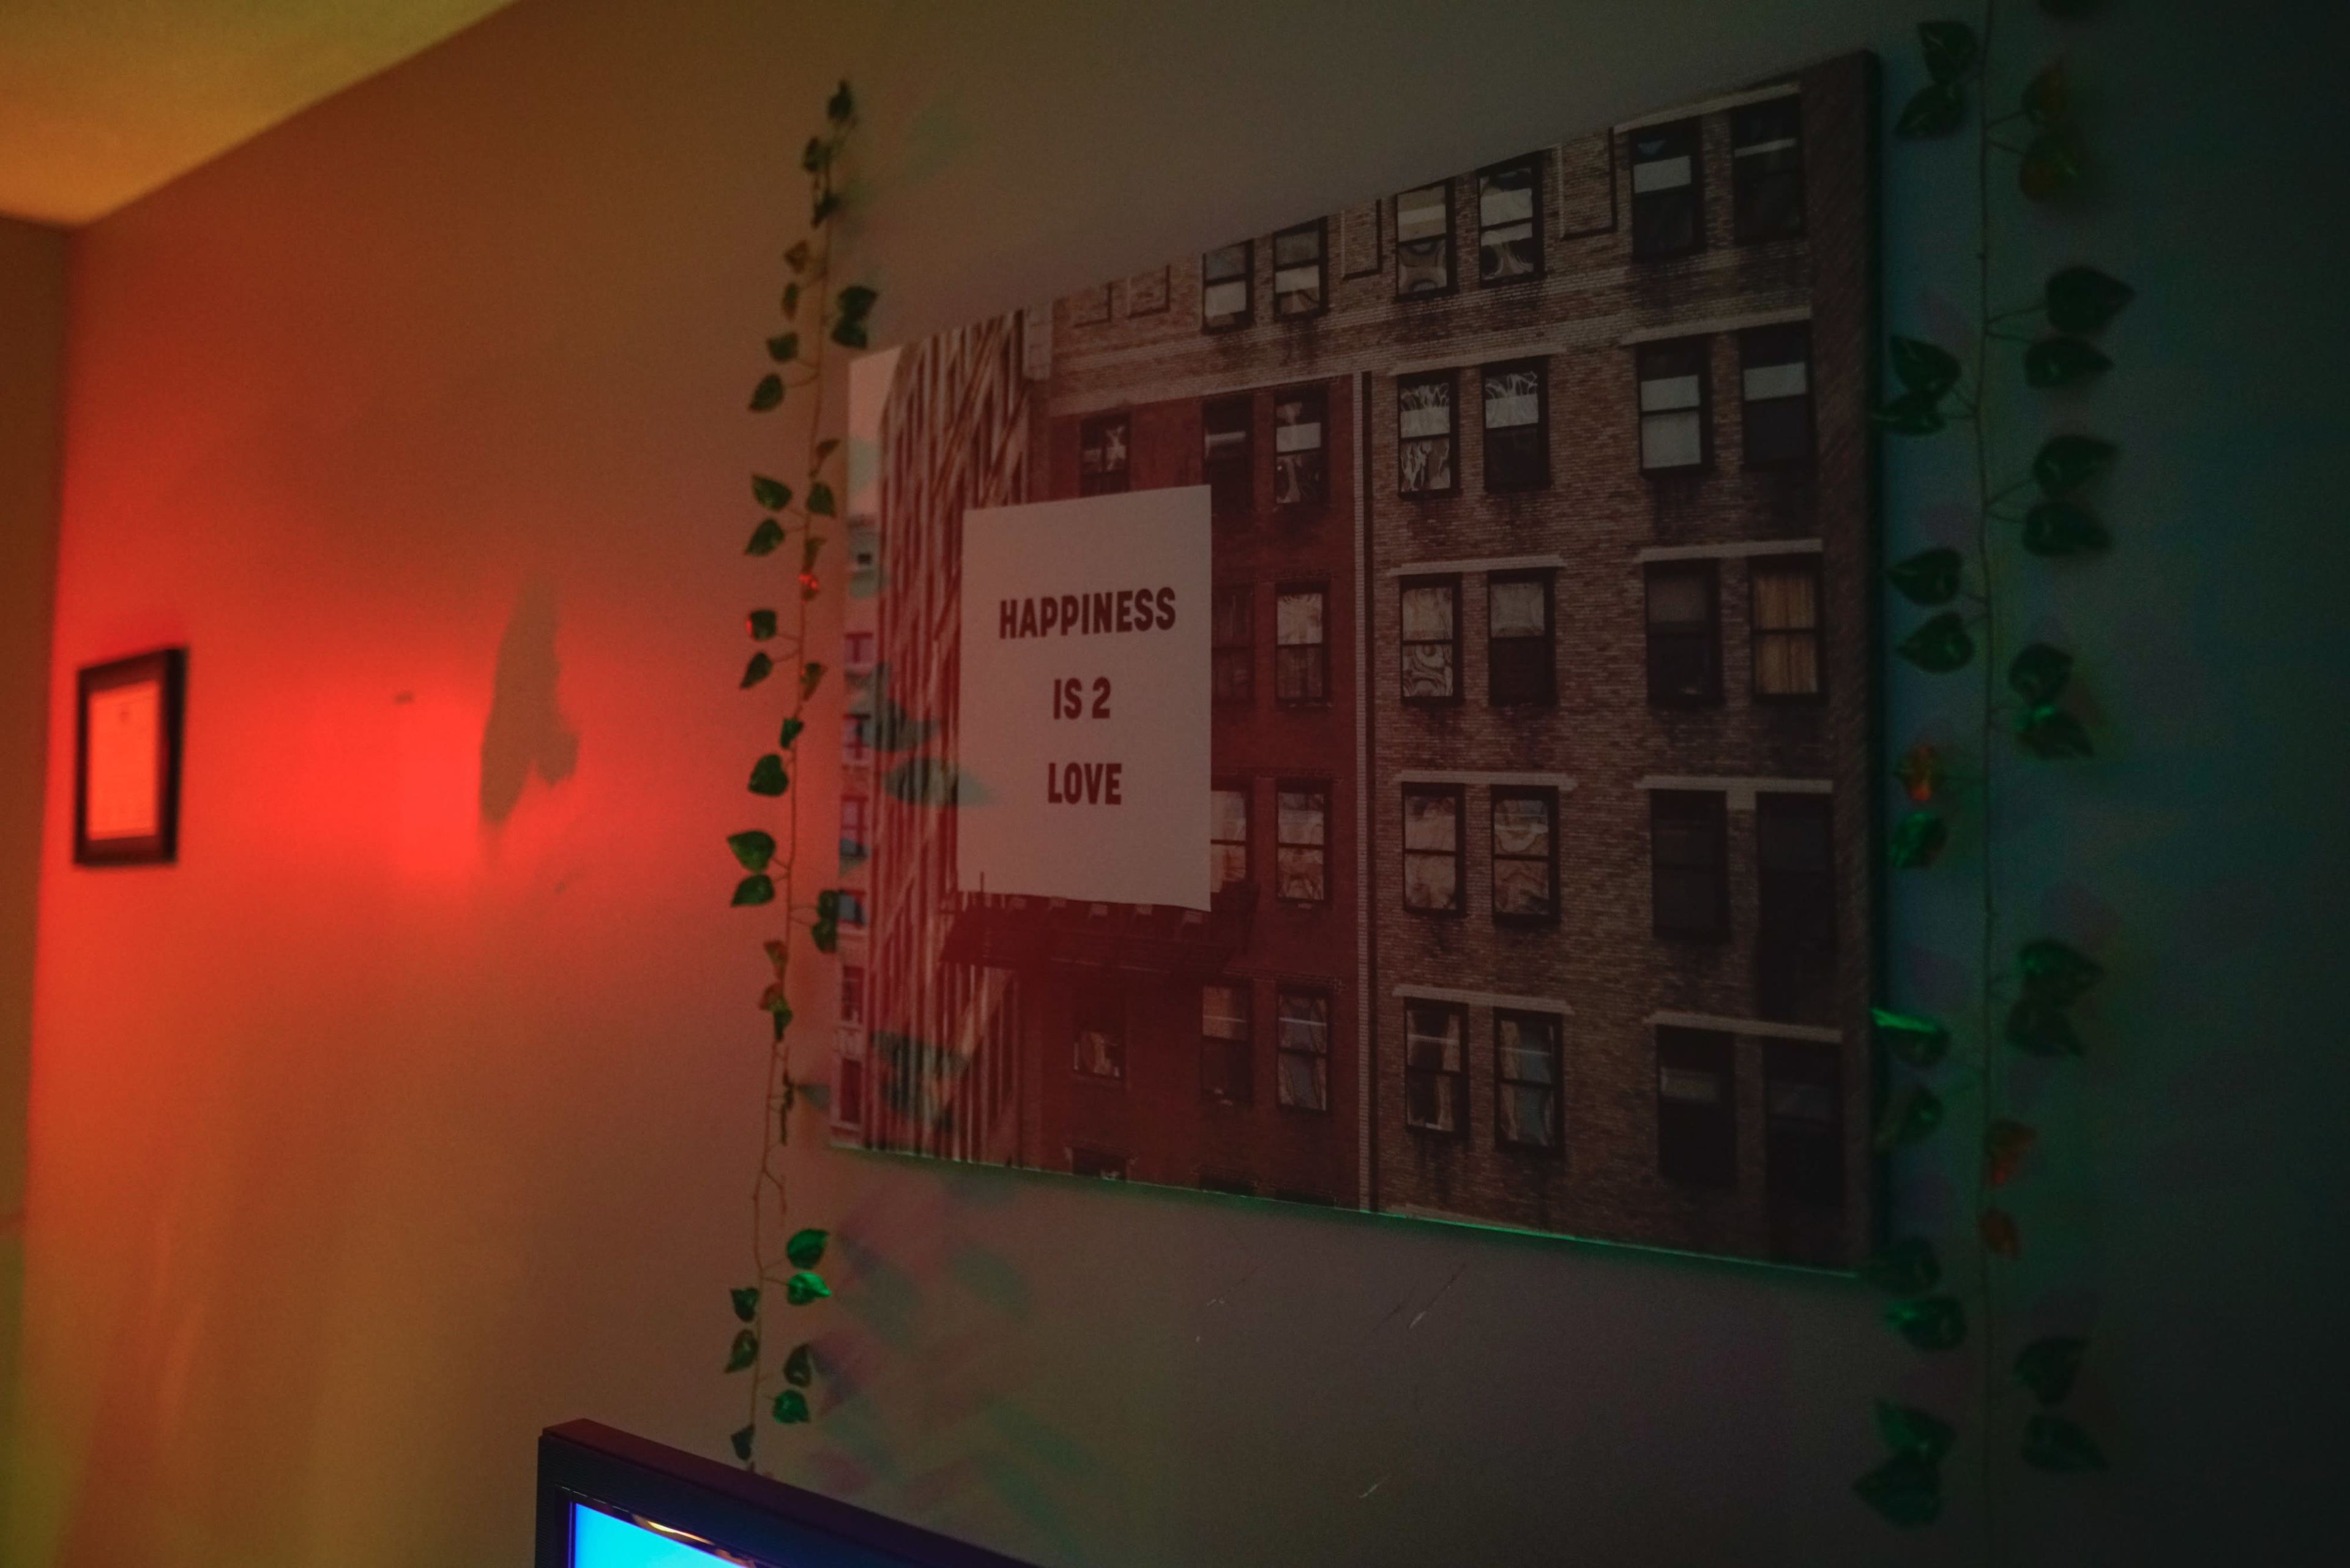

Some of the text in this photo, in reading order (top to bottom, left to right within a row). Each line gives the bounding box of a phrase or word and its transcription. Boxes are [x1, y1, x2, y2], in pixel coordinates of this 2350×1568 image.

[999, 588, 1176, 638] HAPPINESS
[1053, 677, 1111, 719] IS 2
[1048, 763, 1122, 804] LOVE
